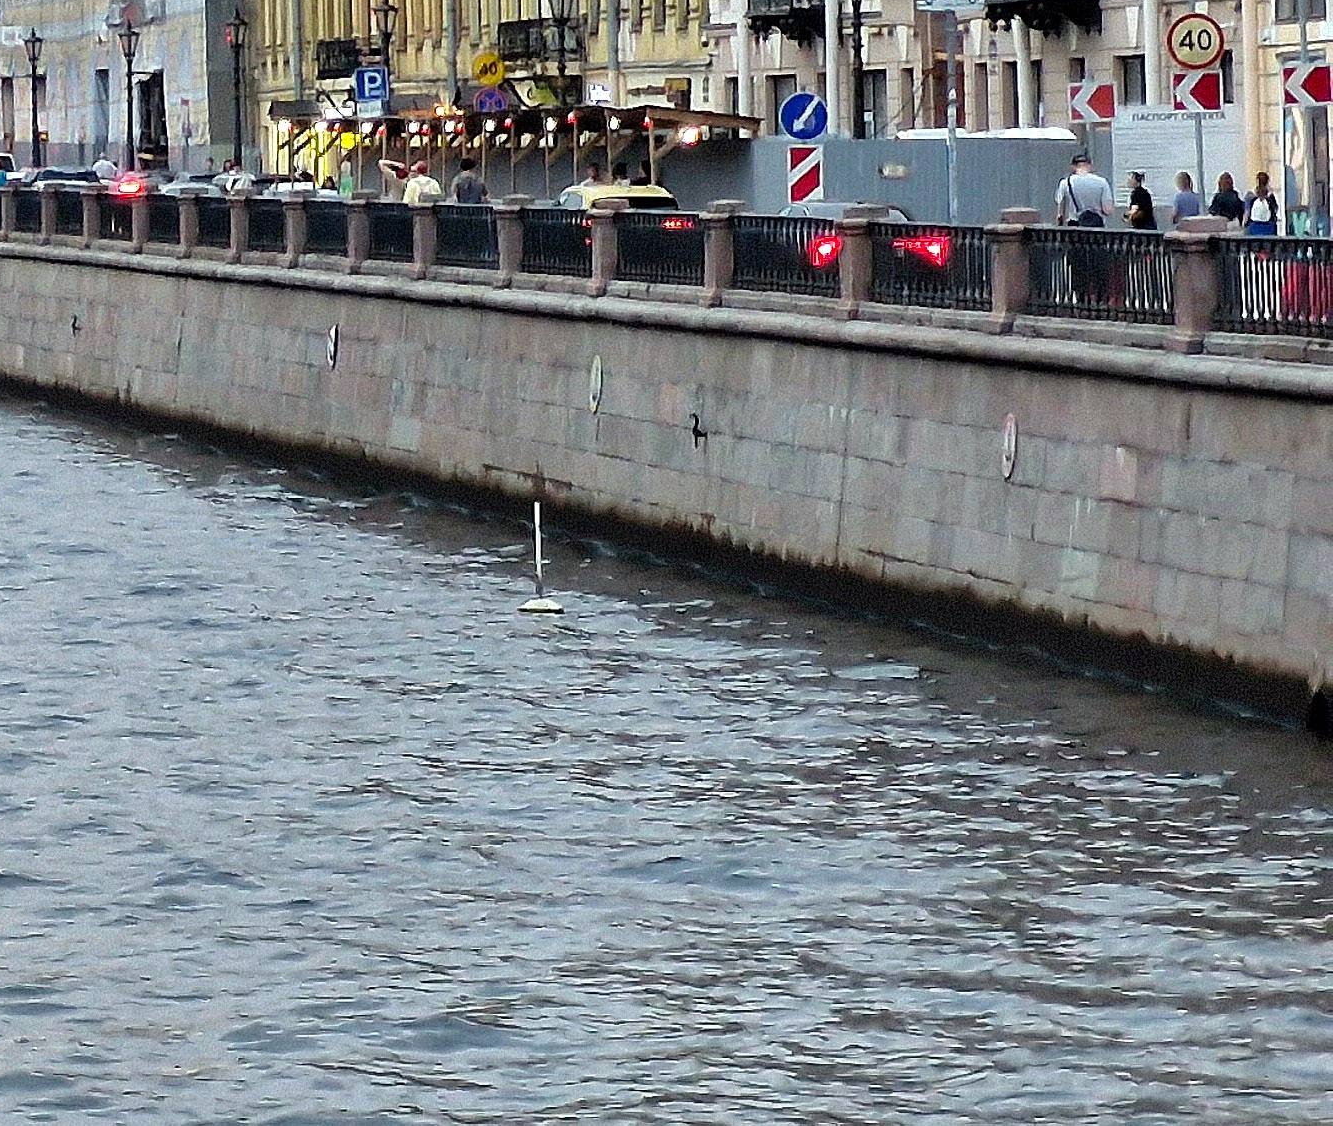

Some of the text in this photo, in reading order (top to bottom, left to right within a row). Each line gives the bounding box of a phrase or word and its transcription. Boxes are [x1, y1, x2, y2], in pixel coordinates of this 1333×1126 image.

[1179, 29, 1212, 51] 40
[364, 71, 382, 97] P
[1131, 112, 1178, 122] ПАСПОРТ
